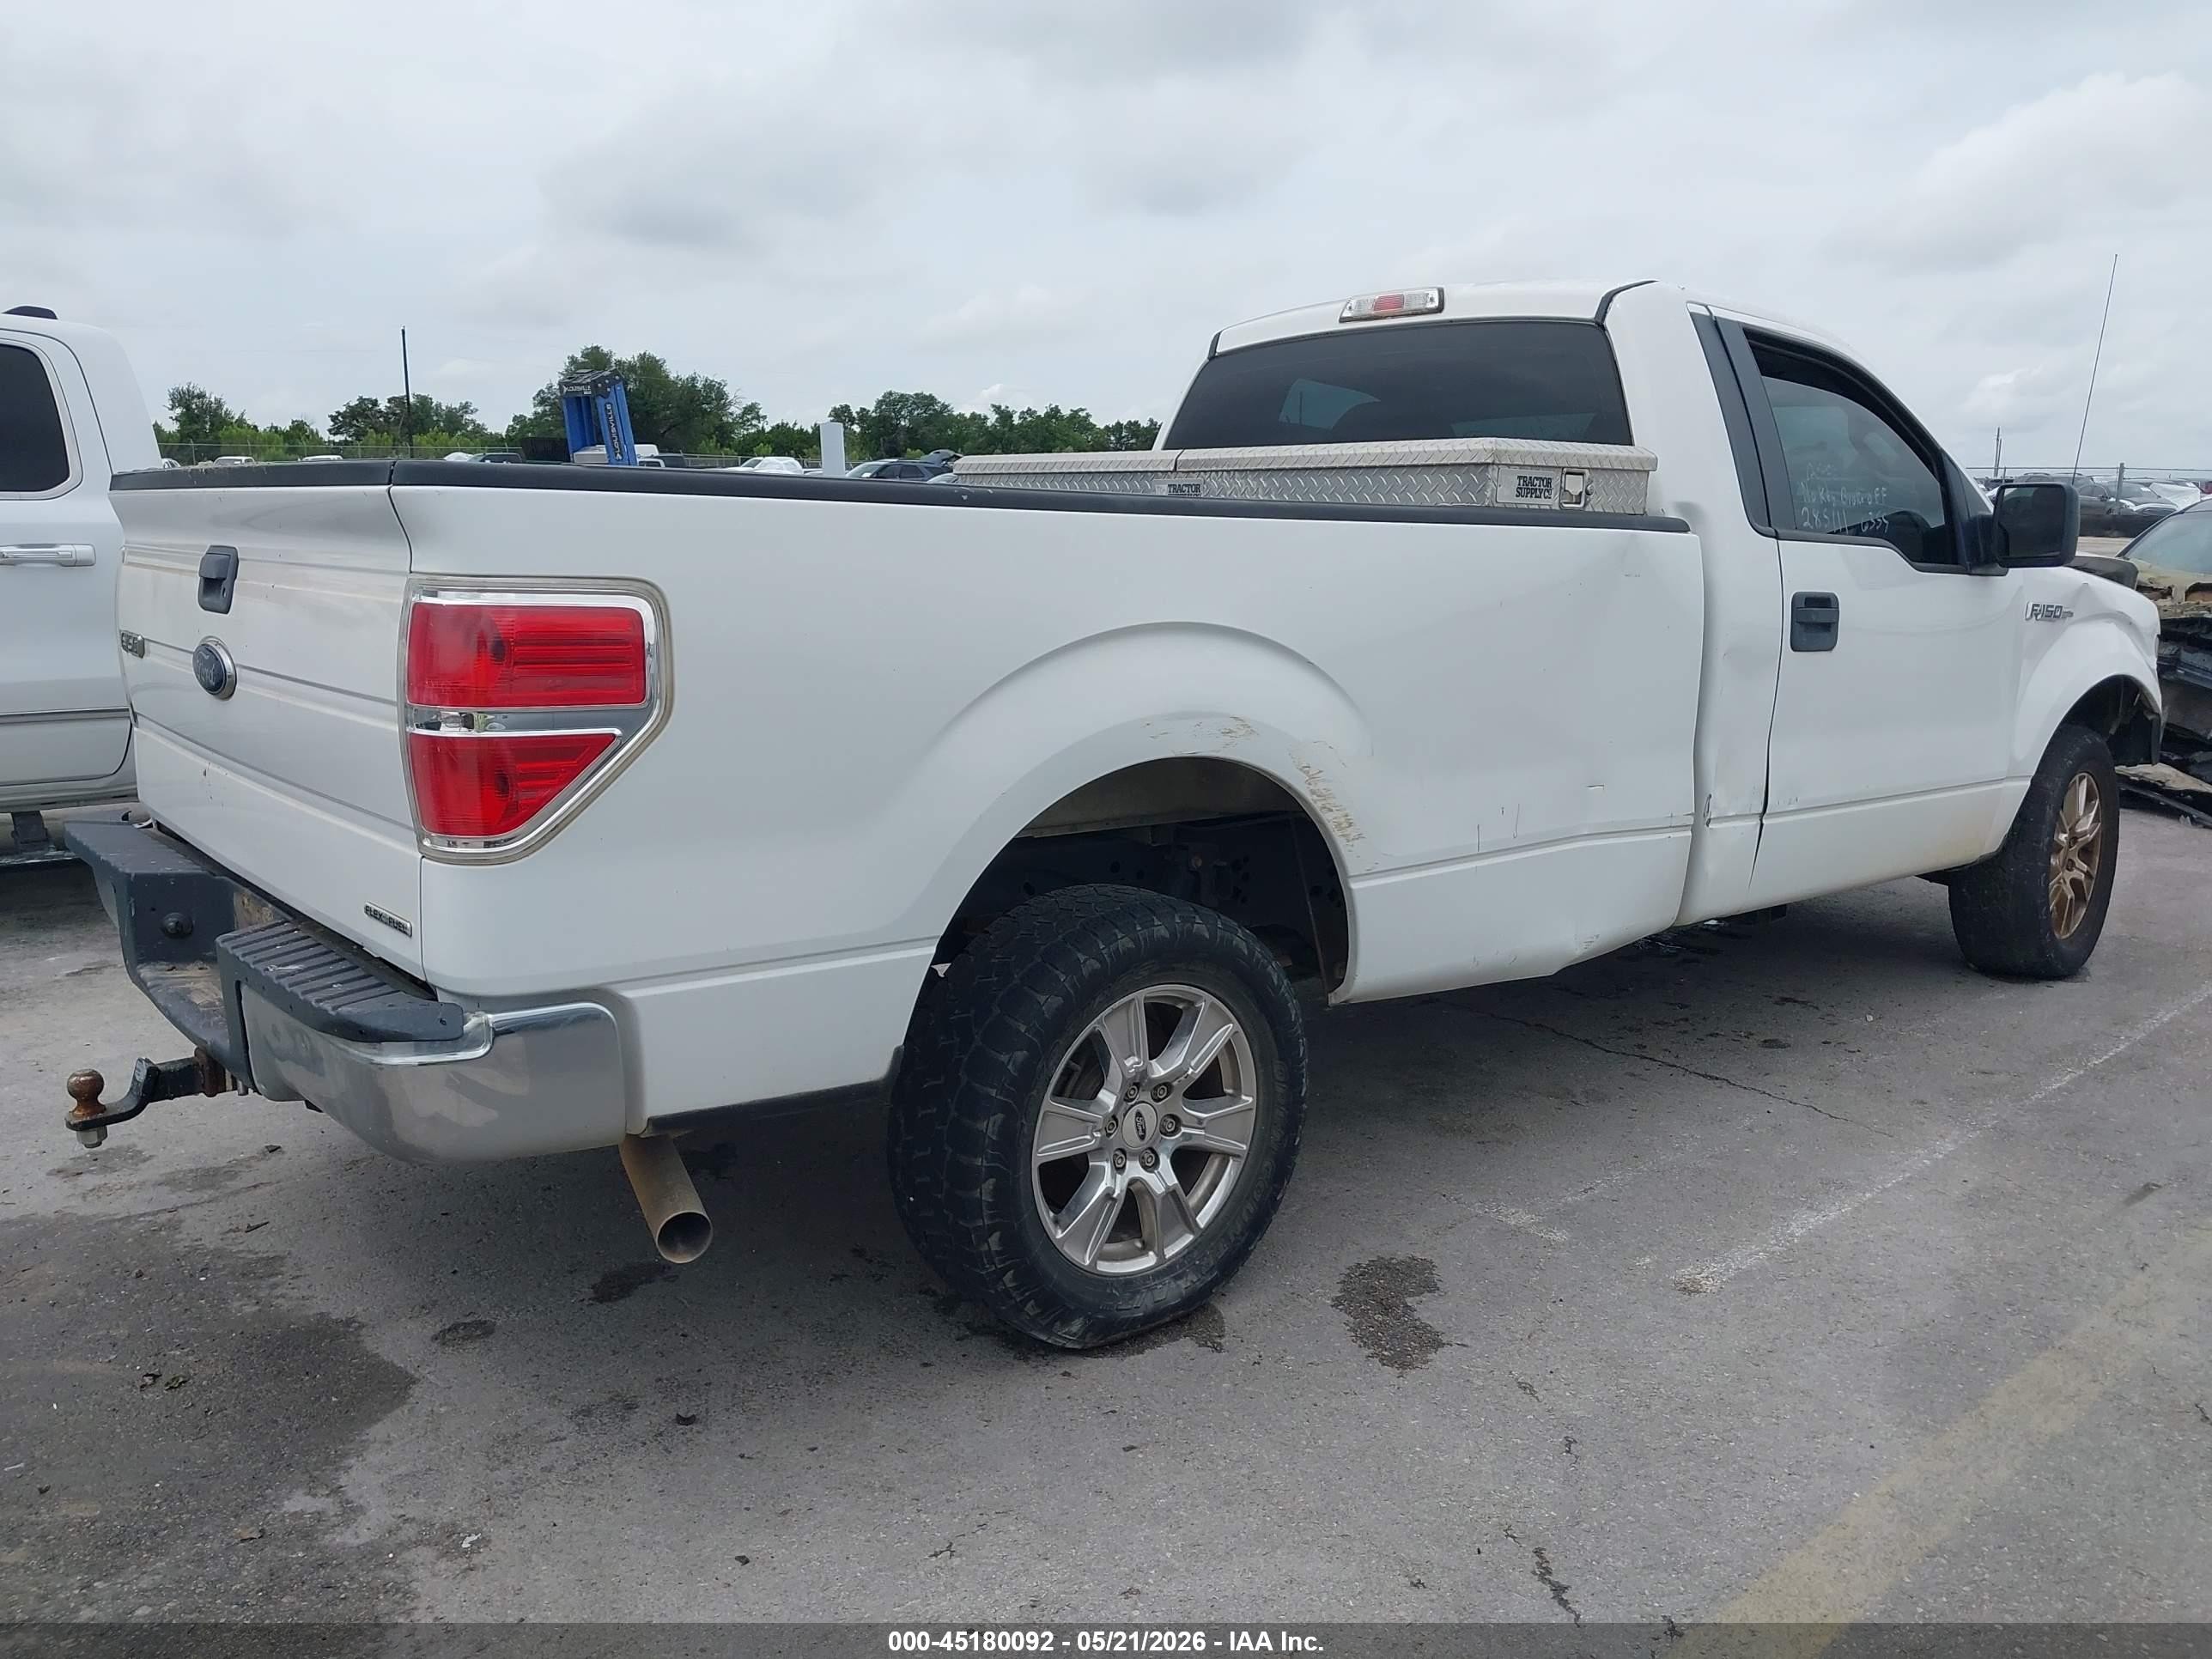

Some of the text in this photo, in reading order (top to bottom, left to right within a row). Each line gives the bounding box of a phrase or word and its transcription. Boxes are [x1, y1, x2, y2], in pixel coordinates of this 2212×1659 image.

[1516, 476, 1553, 488] TRACTOR
[1168, 483, 1200, 494] TRACTOR
[1516, 487, 1543, 499] SUPPLY
